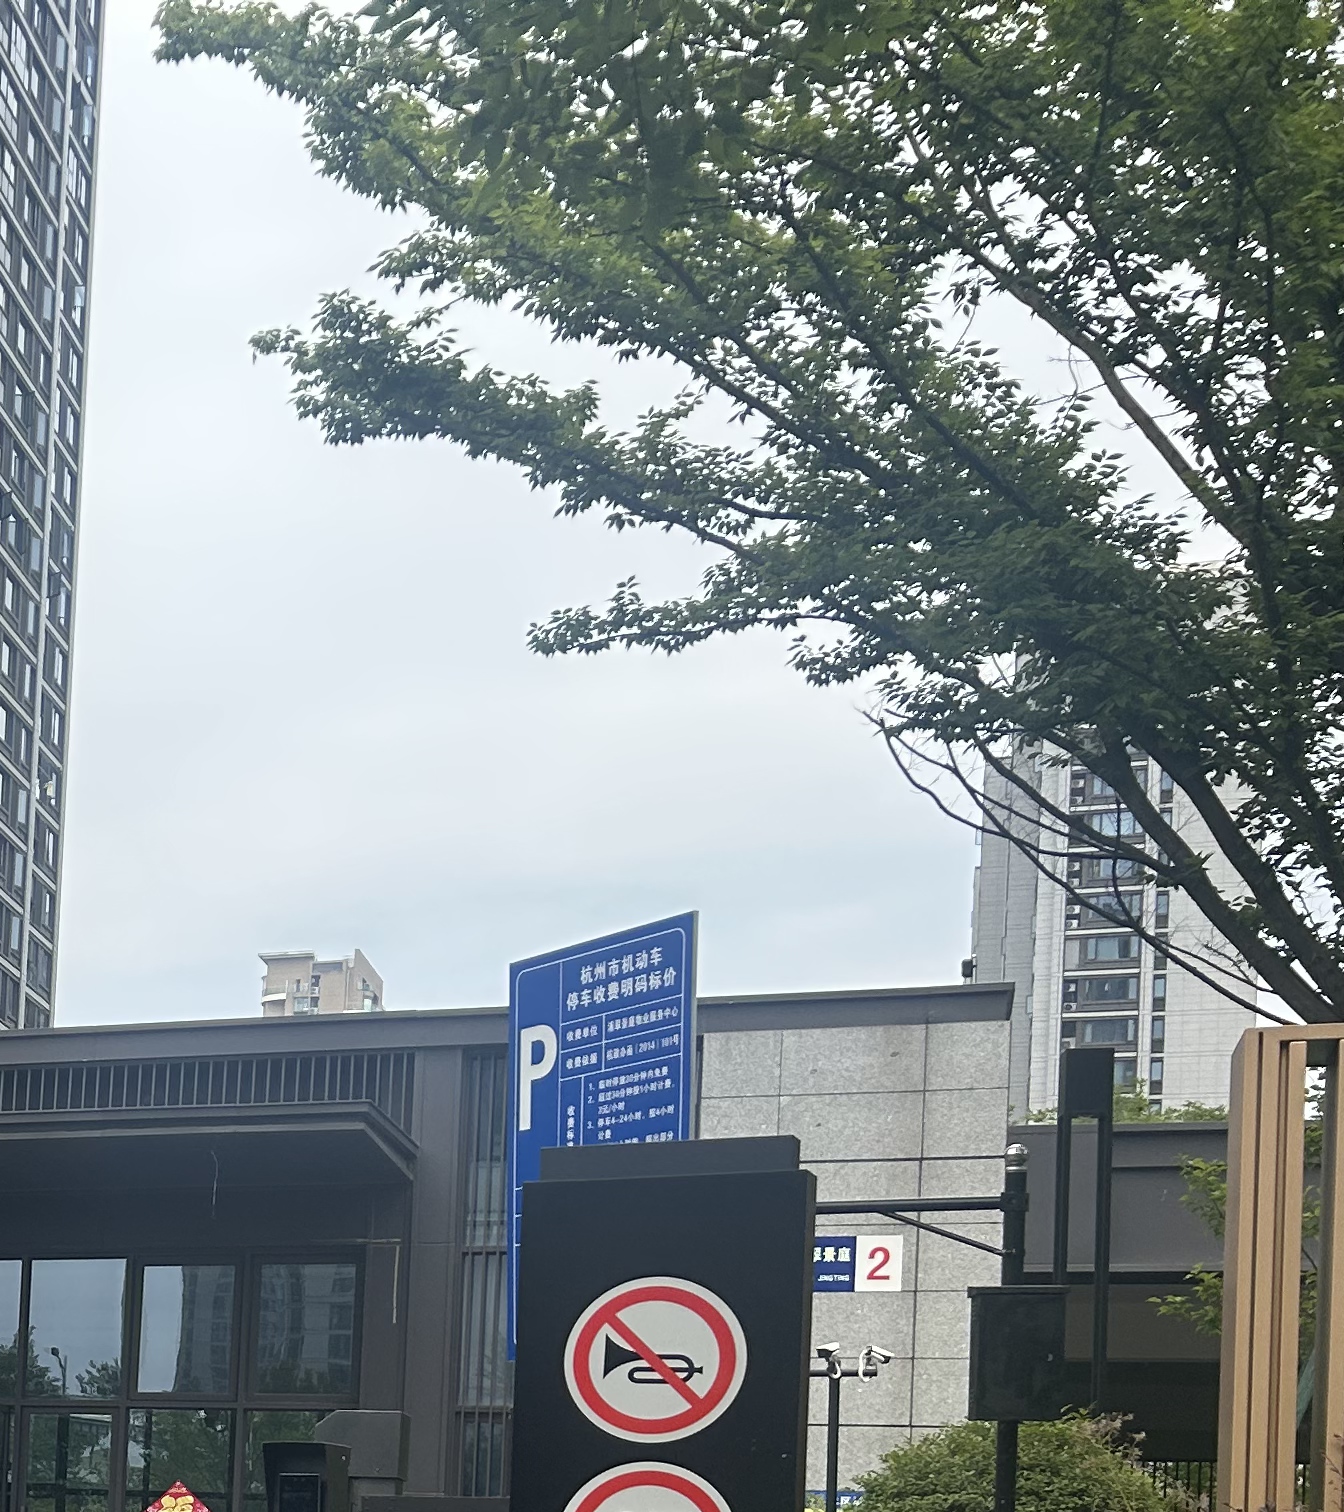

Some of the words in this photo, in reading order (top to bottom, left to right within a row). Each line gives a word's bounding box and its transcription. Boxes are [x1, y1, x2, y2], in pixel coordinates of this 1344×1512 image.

[580, 947, 663, 984] 杭州市机动车
[566, 966, 676, 1011] 停车收费明码标价
[566, 1025, 598, 1041] 收费单位
[519, 1024, 557, 1131] P
[866, 1246, 890, 1280] 2
